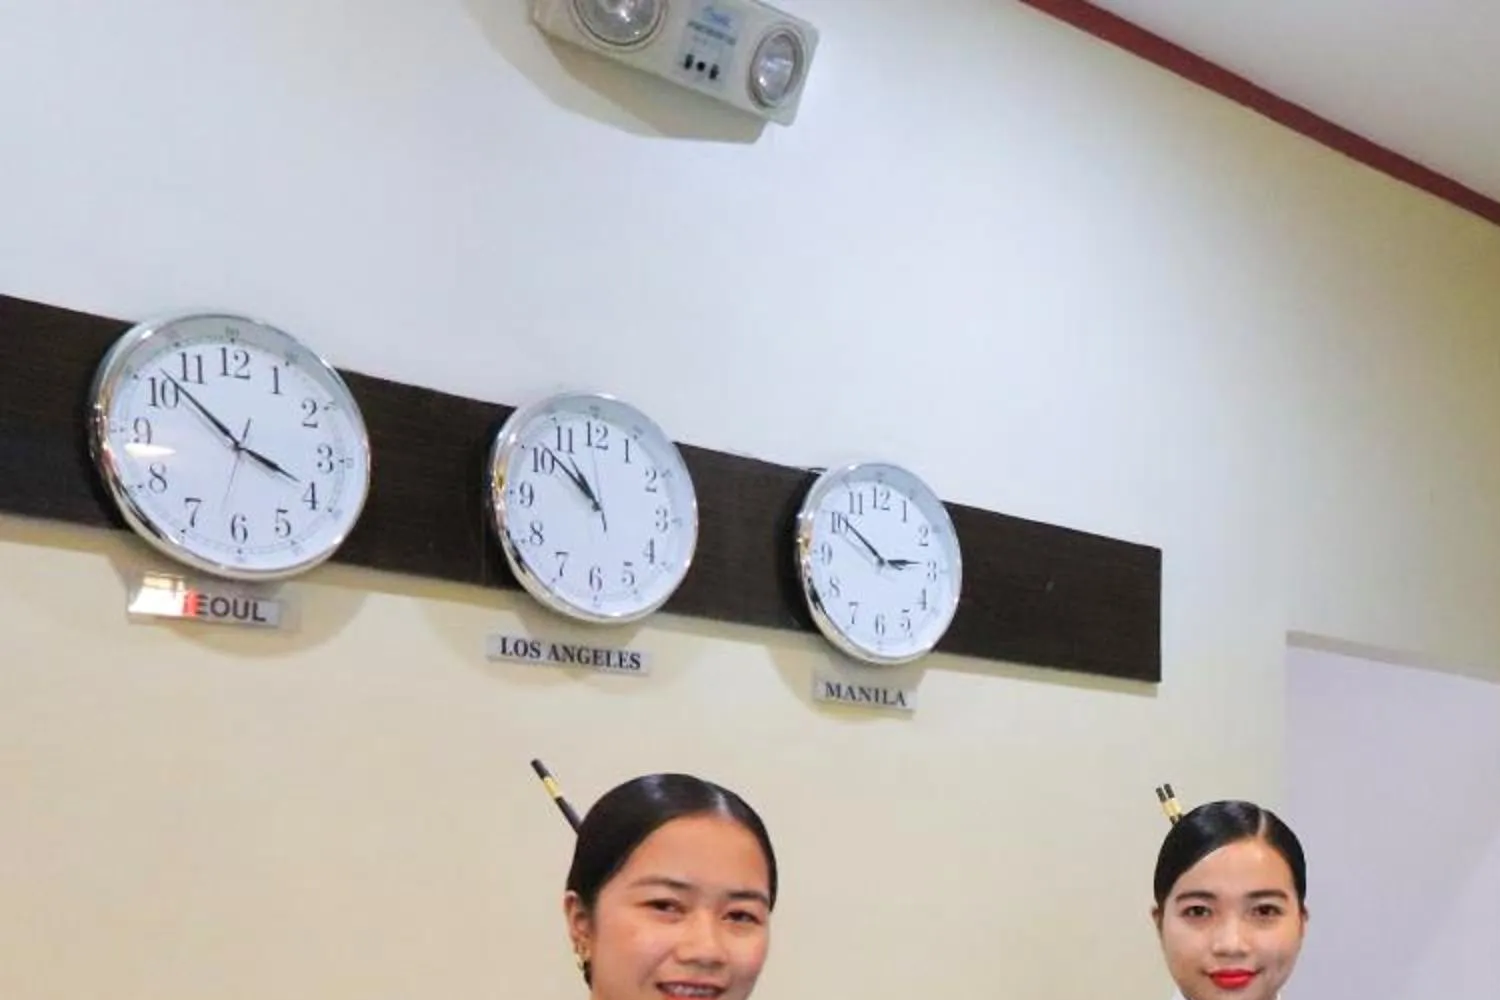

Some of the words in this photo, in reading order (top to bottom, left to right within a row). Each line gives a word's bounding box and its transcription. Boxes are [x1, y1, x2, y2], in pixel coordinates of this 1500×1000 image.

[178, 352, 207, 385] 11
[219, 347, 251, 379] 12
[148, 376, 180, 409] 10
[270, 366, 283, 395] 1
[301, 398, 318, 428] 2
[133, 418, 152, 445] 9
[555, 425, 575, 455] 11
[585, 421, 609, 450] 12
[317, 443, 334, 473] 3
[623, 439, 631, 464] 1
[149, 462, 168, 493] 8
[645, 468, 658, 493] 2
[302, 481, 317, 511] 4
[519, 482, 534, 508] 9
[184, 497, 202, 528] 7
[275, 509, 291, 537] 5
[656, 508, 668, 533] 3
[231, 514, 248, 543] 6
[529, 520, 544, 546] 8
[556, 551, 569, 577] 7
[643, 539, 655, 565] 4
[589, 566, 603, 591] 6
[622, 562, 635, 587] 5
[183, 594, 267, 622] EOUL
[500, 637, 541, 659] LOS
[547, 644, 642, 671] ANGELES
[825, 680, 907, 706] MANILA
